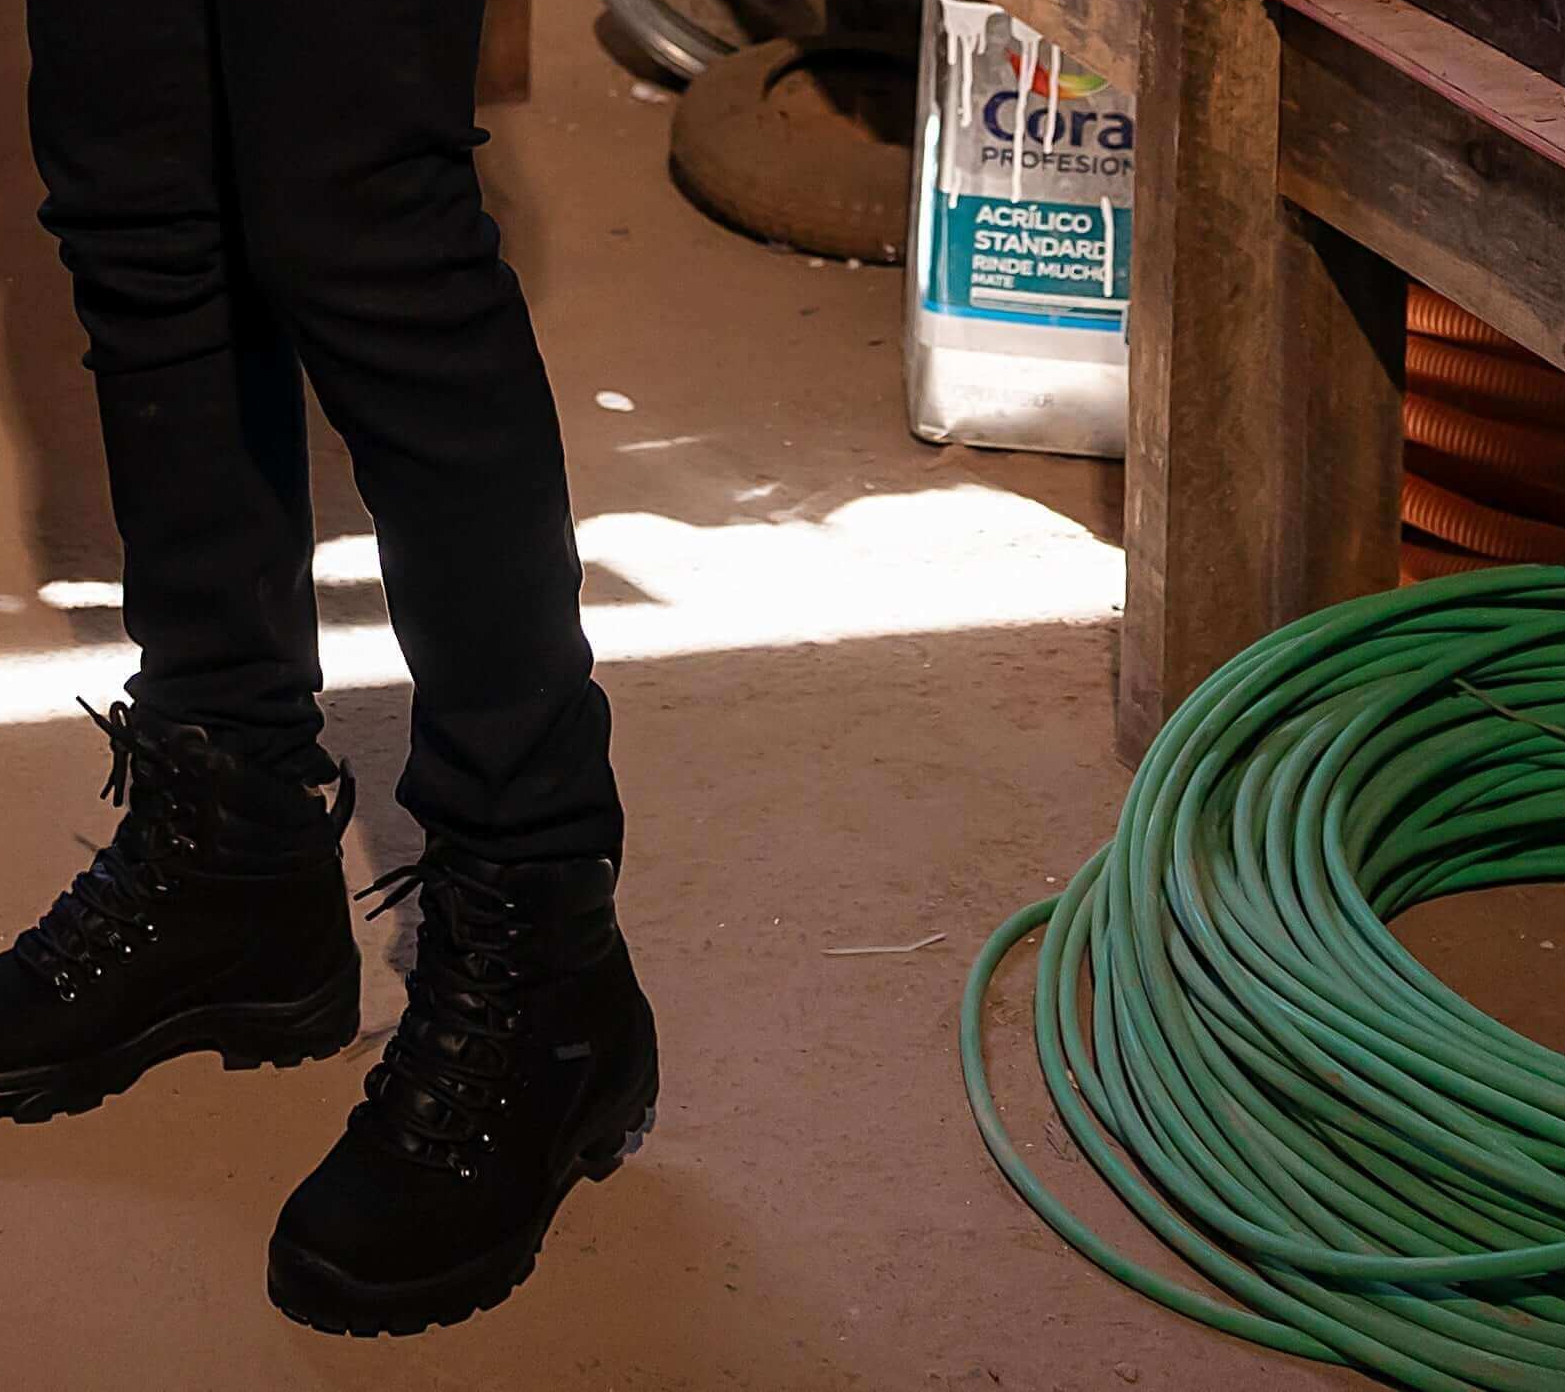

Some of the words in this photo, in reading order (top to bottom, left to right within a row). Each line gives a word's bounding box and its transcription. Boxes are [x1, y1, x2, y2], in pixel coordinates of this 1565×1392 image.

[975, 204, 1092, 234] ACRÍLICO
[972, 254, 1034, 276] RINDE
[971, 272, 1015, 289] MATE
